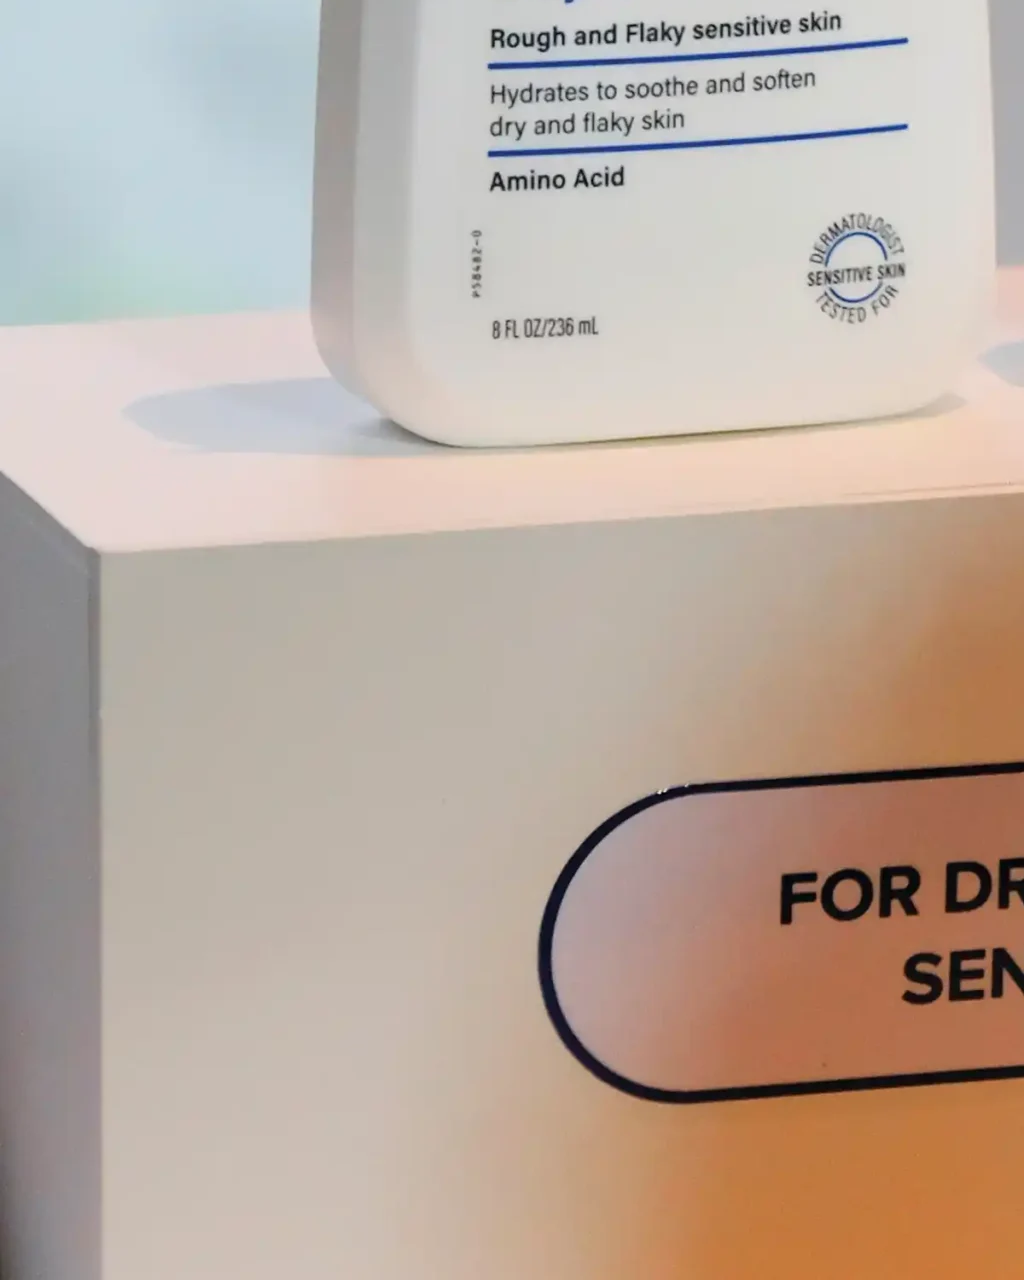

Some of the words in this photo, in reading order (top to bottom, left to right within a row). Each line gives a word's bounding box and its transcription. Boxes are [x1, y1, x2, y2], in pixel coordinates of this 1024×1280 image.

[491, 26, 565, 52] Rough
[574, 24, 617, 45] and
[626, 21, 685, 48] Flaky
[693, 13, 791, 40] sensitive
[799, 11, 841, 32] skin
[491, 83, 589, 109] Hydrates
[597, 82, 617, 100] to
[625, 76, 698, 99] soothe
[706, 72, 744, 94] and
[753, 69, 815, 91] soften
[490, 116, 526, 141] dry
[534, 113, 575, 135] and
[583, 112, 634, 136] flaky
[642, 109, 684, 130] skin
[490, 170, 565, 191] Amino
[574, 166, 624, 187] Acid
[808, 211, 905, 265] DERMATOLOGIST
[807, 265, 873, 287] SENSITIVE
[877, 263, 906, 280] SKIN
[816, 291, 867, 324] TESTED
[871, 285, 900, 316] FOR
[492, 320, 501, 339] 8
[505, 320, 519, 338] FL
[578, 317, 598, 335] mL
[780, 865, 921, 925] FOR
